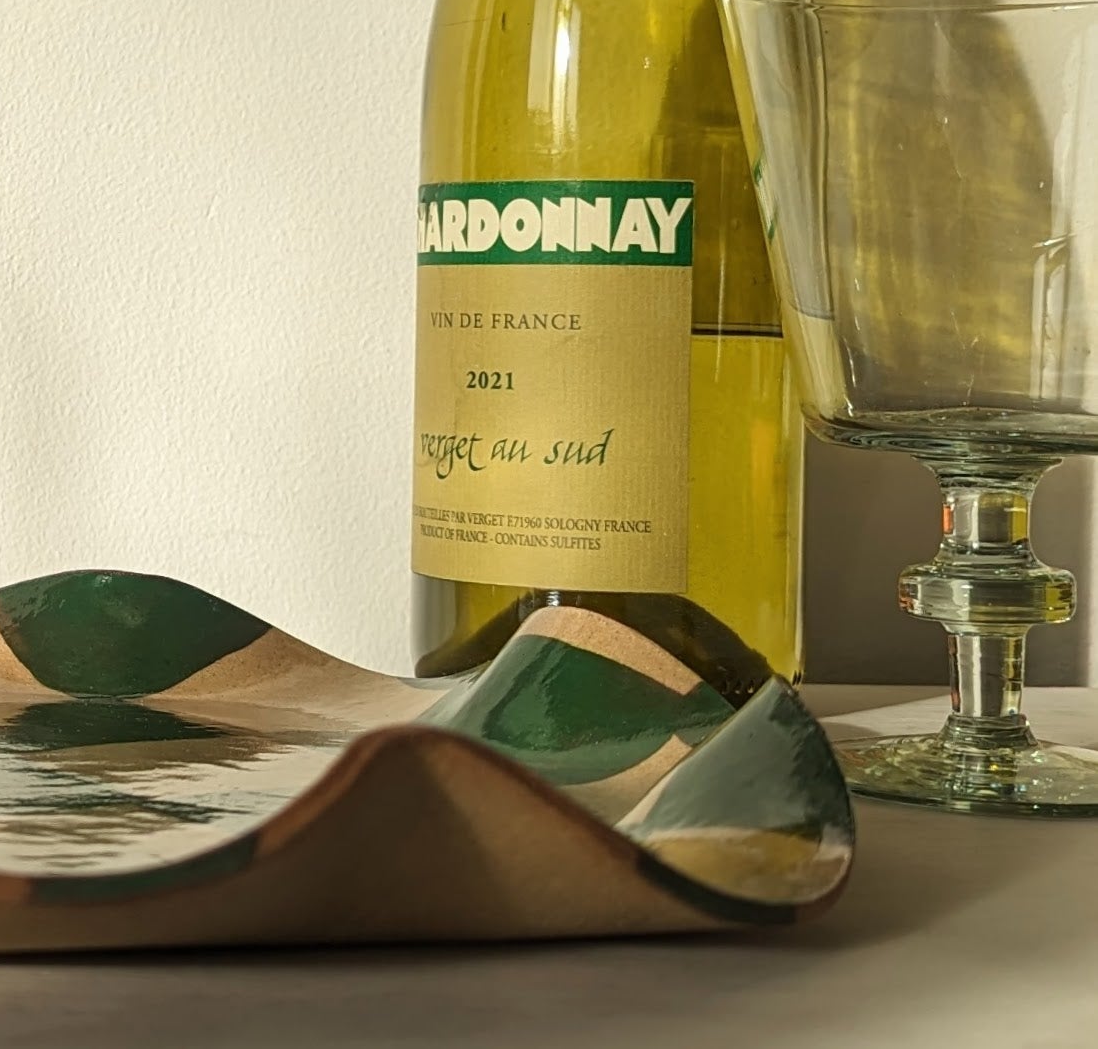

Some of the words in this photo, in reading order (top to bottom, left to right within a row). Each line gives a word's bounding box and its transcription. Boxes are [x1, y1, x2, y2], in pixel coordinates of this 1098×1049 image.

[430, 311, 454, 329] VIN
[459, 312, 483, 329] DE
[491, 313, 582, 331] FRANCE
[466, 370, 515, 390] 2021
[420, 431, 487, 480] verget
[490, 437, 532, 464] au
[543, 428, 615, 466] sud
[467, 512, 504, 527] VERGET
[544, 517, 601, 532] SOLOGNY
[604, 520, 652, 534] FRANCE
[456, 529, 488, 544] FRANCE
[495, 532, 548, 547] CONTAINS
[552, 537, 601, 551] SULFITES
